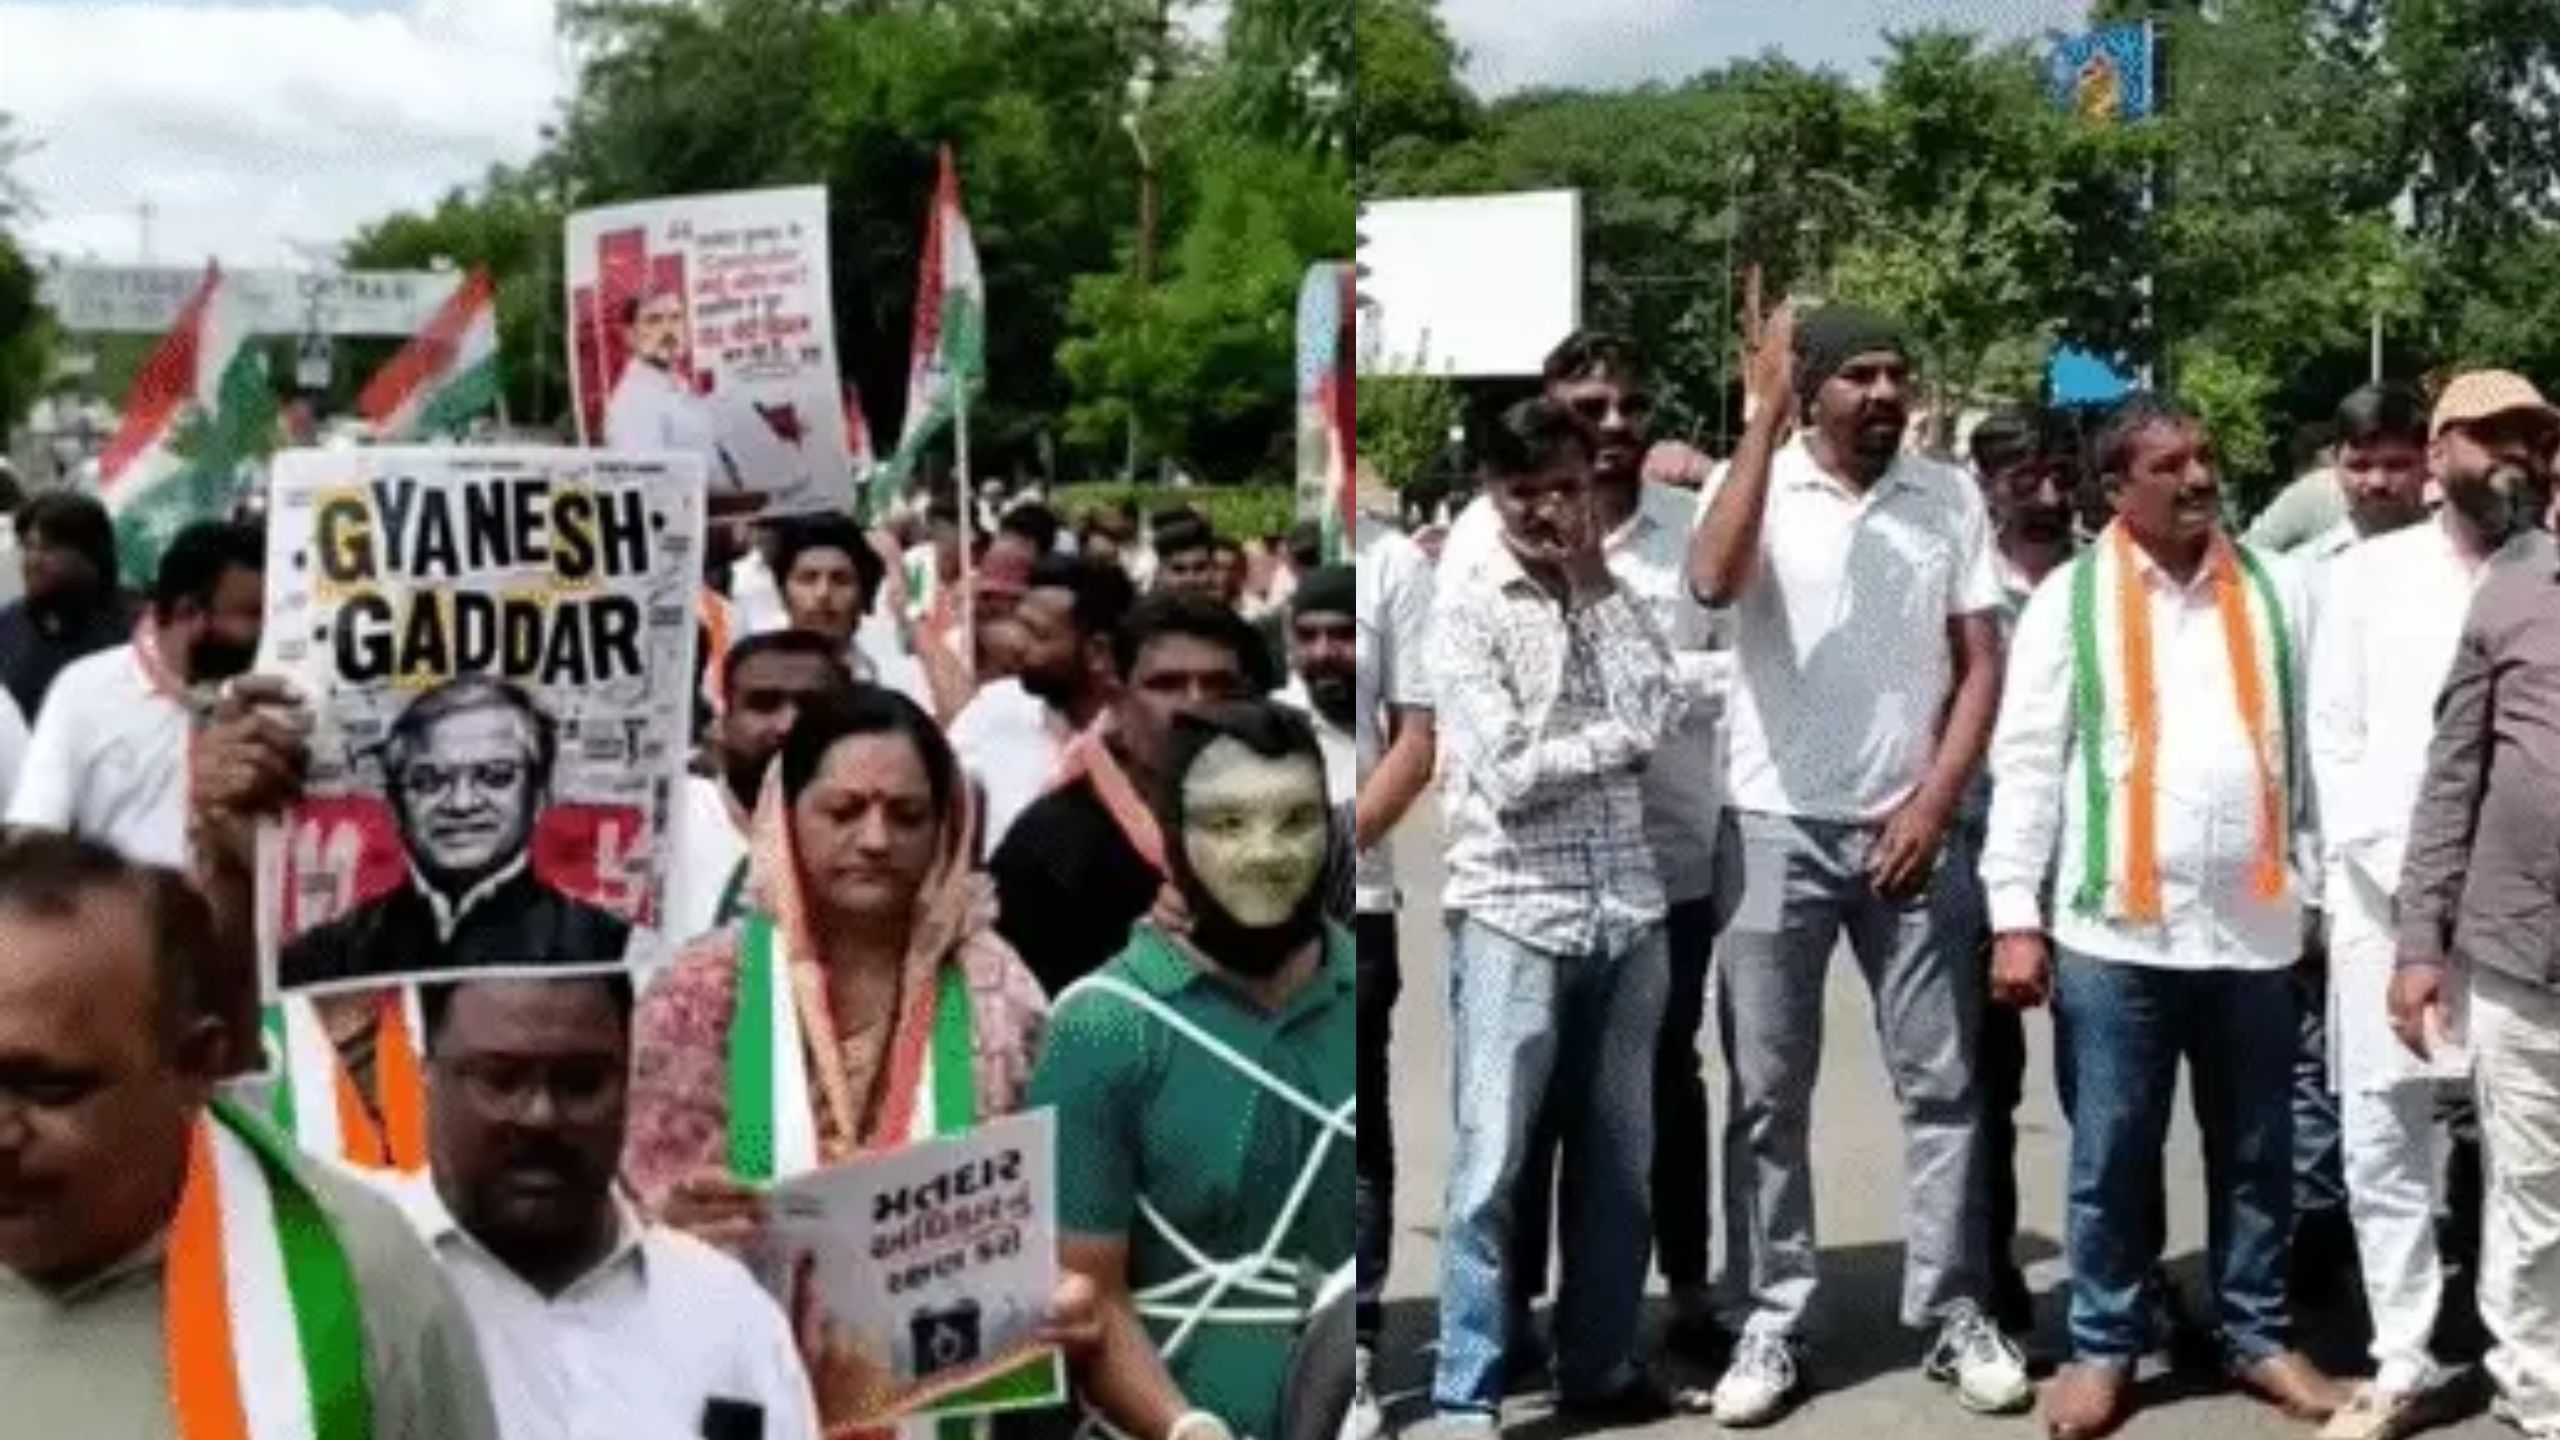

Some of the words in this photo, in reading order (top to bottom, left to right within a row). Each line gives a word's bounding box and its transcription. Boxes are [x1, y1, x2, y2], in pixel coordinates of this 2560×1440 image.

[318, 476, 650, 582] GYANESH
[335, 590, 643, 686] GADDAR
[872, 1148, 1022, 1224] મતદાર
